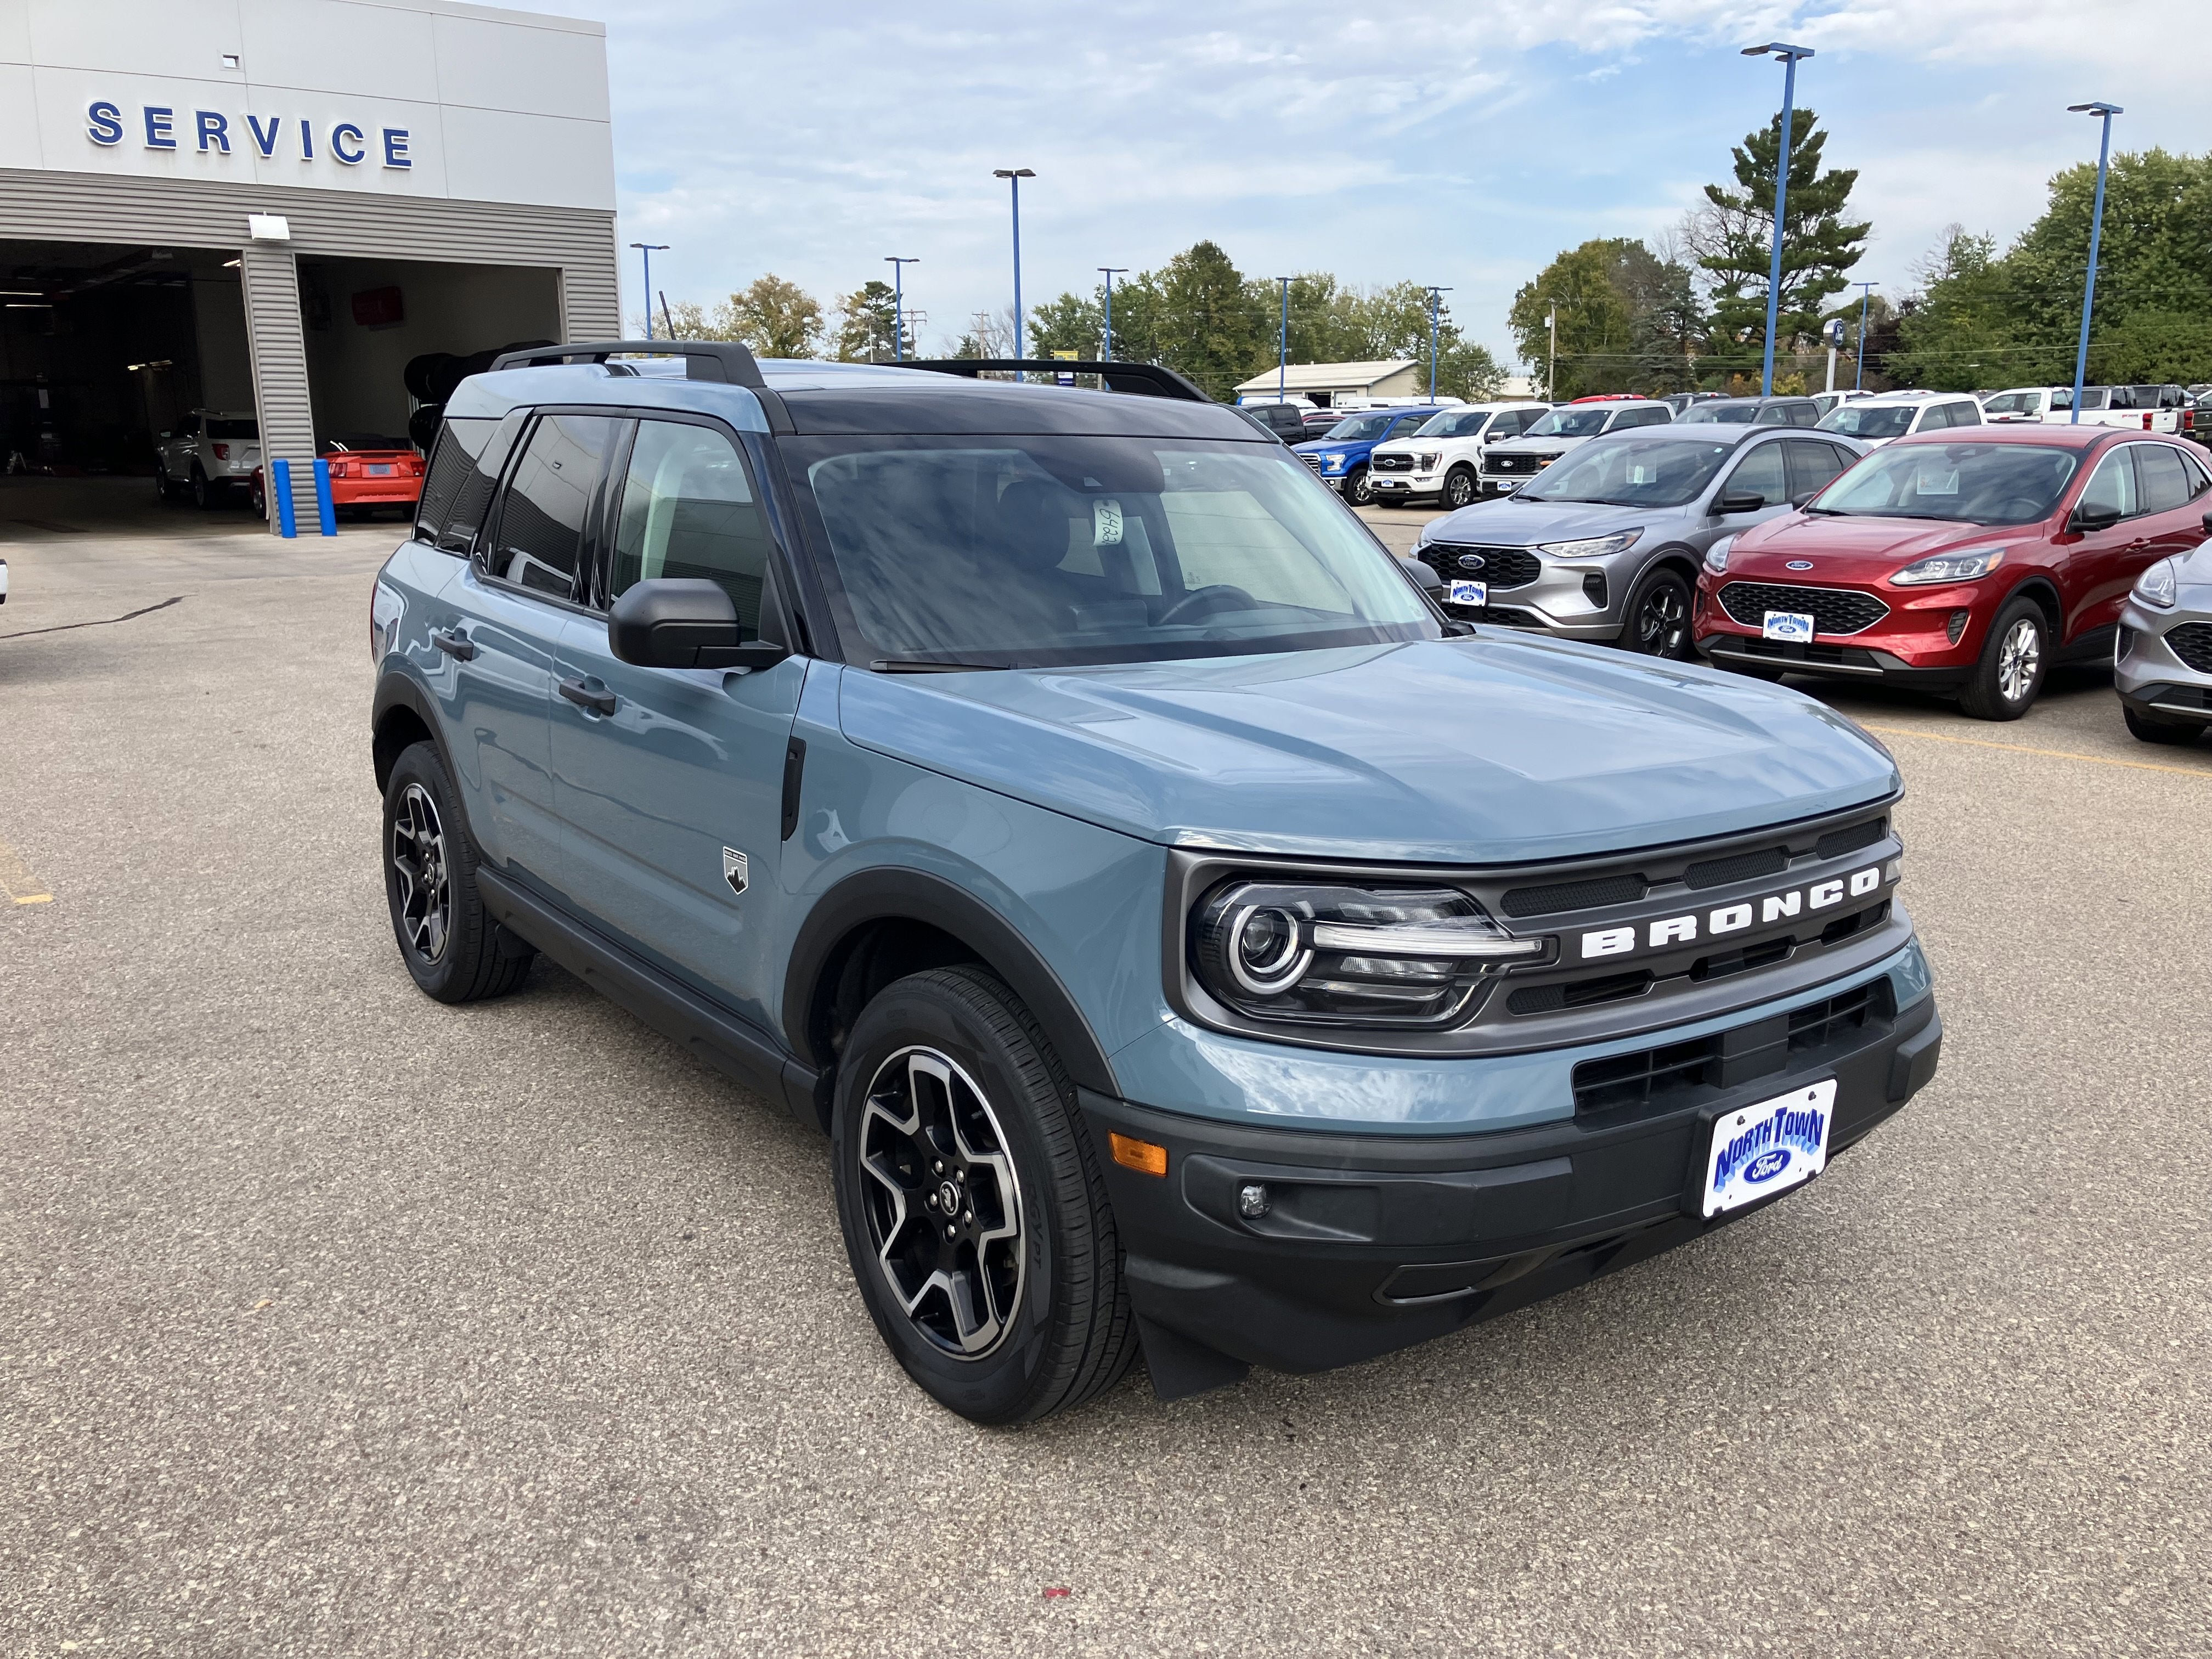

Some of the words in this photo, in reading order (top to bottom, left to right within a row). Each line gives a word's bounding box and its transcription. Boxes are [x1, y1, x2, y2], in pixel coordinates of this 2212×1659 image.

[86, 99, 414, 169] SERVICE
[1581, 867, 1880, 958] BRONCO
[1752, 1153, 1782, 1180] Ford
